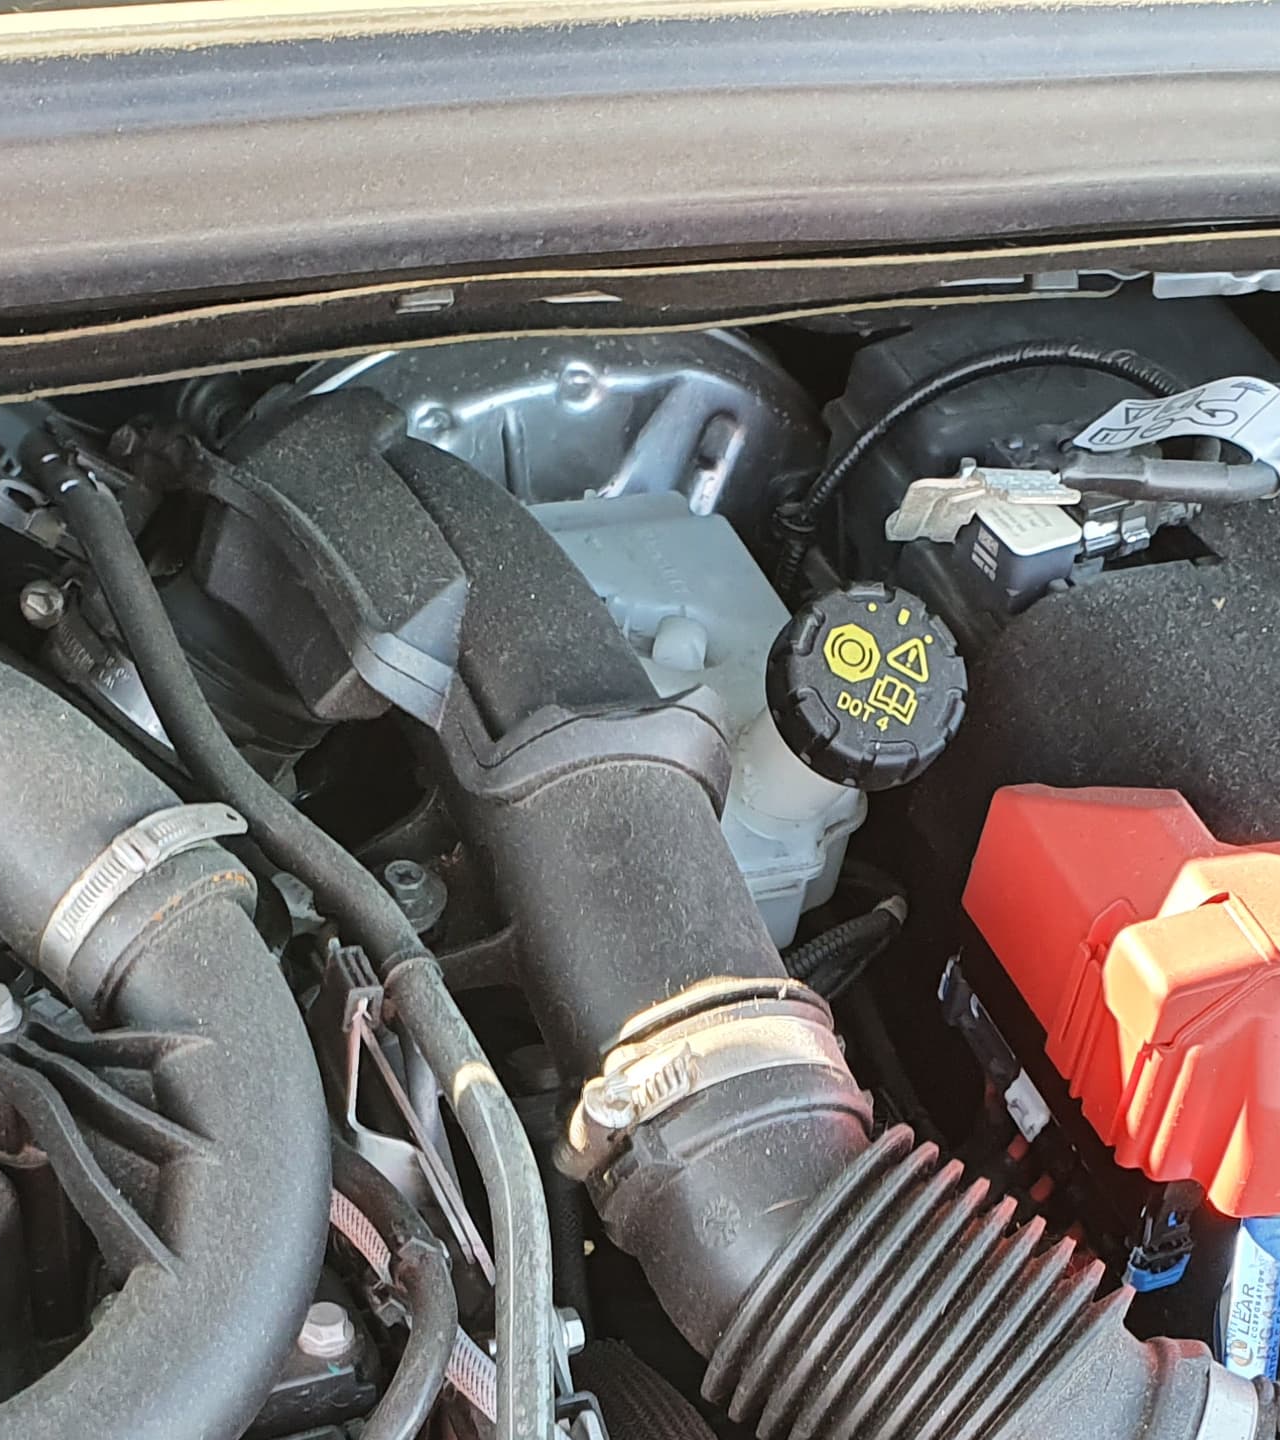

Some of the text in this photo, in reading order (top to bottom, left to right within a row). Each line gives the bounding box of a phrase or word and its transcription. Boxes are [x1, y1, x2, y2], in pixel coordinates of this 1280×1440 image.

[837, 691, 889, 732] DOT 4
[1237, 1284, 1256, 1336] LEAR
